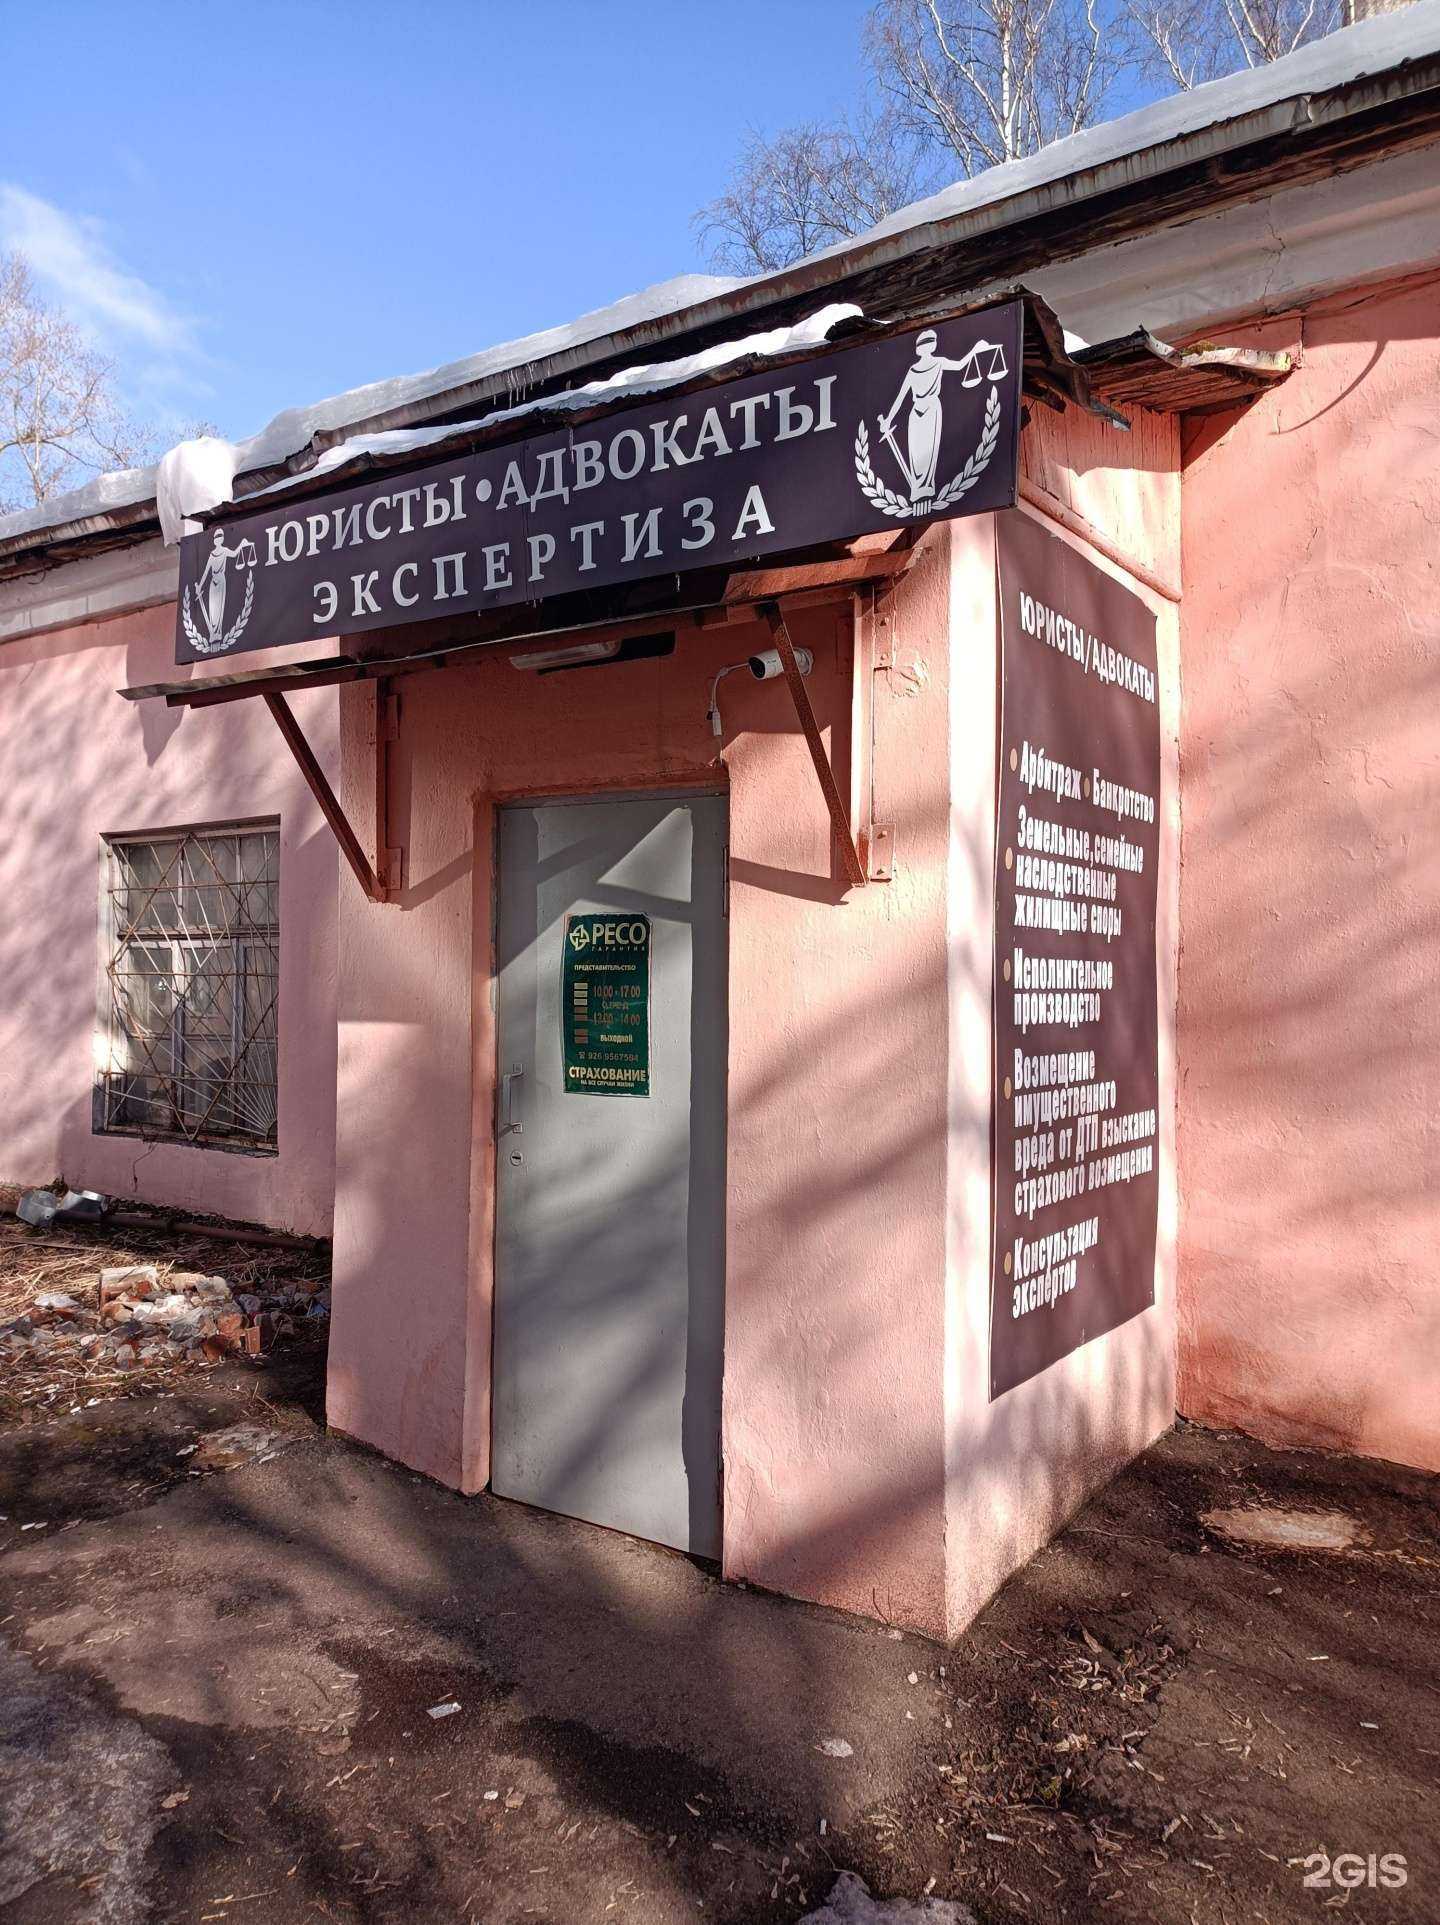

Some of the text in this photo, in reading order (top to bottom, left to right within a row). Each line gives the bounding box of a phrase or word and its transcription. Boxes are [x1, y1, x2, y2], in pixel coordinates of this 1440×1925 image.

[265, 375, 837, 566] ЮРИСТЫ АДВОКАТЫ
[313, 485, 775, 624] ЭКСПЕРТИЗА
[1020, 741, 1154, 824] Арбитраж Банкротство
[1016, 854, 1117, 902] наследственные
[592, 922, 647, 945] РЕСО
[1014, 894, 1122, 943] жилищные споры
[1014, 948, 1113, 990] Исполнительное
[1014, 993, 1100, 1034] производство
[569, 1065, 646, 1082] СТРАХОВАНИЕ
[1014, 1048, 1096, 1090] Возмещение
[1014, 1080, 1116, 1133] имущественного
[1015, 1108, 1156, 1179] вреда от ДТП взыскание
[1015, 1145, 1152, 1220] страхового возмещения
[1013, 1216, 1099, 1281] Консультация
[1012, 1259, 1077, 1319] экспертов
